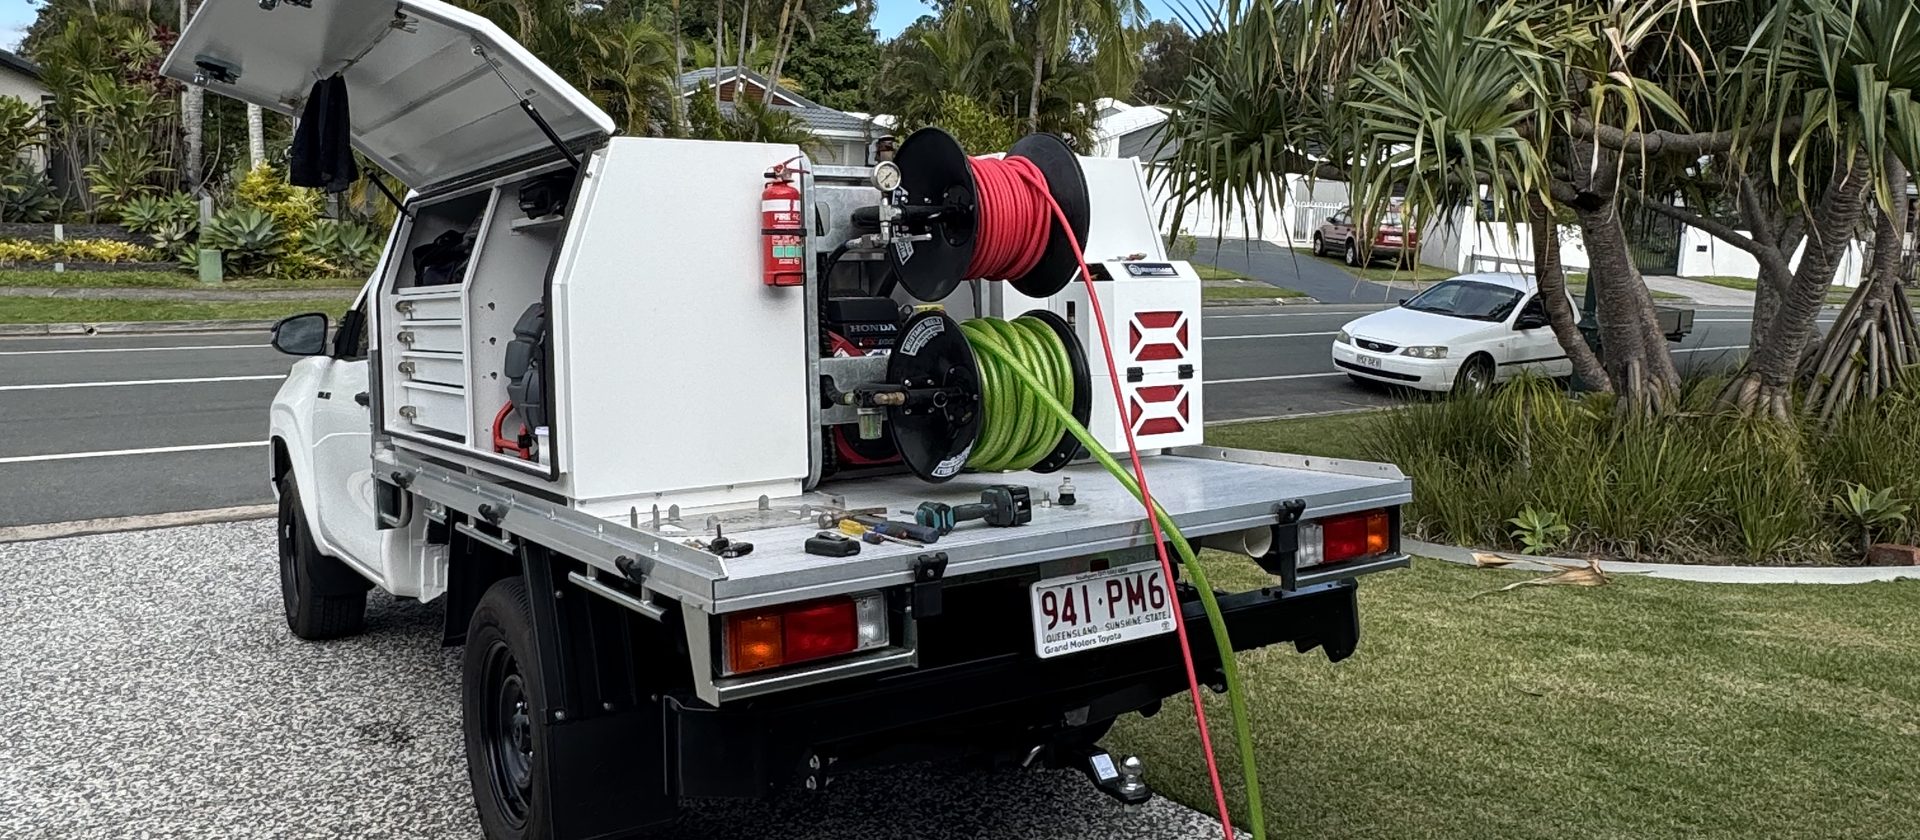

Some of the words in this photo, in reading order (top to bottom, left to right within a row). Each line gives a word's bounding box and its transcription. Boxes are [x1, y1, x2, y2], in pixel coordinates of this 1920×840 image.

[850, 323, 897, 333] HONDA
[1046, 625, 1098, 643] QUEENSLAND
[1105, 617, 1142, 631] SUNSHINE
[1145, 611, 1168, 623] STATE
[1044, 640, 1068, 655] Grand
[1070, 637, 1097, 649] Motors
[1097, 632, 1122, 645] Toyota
